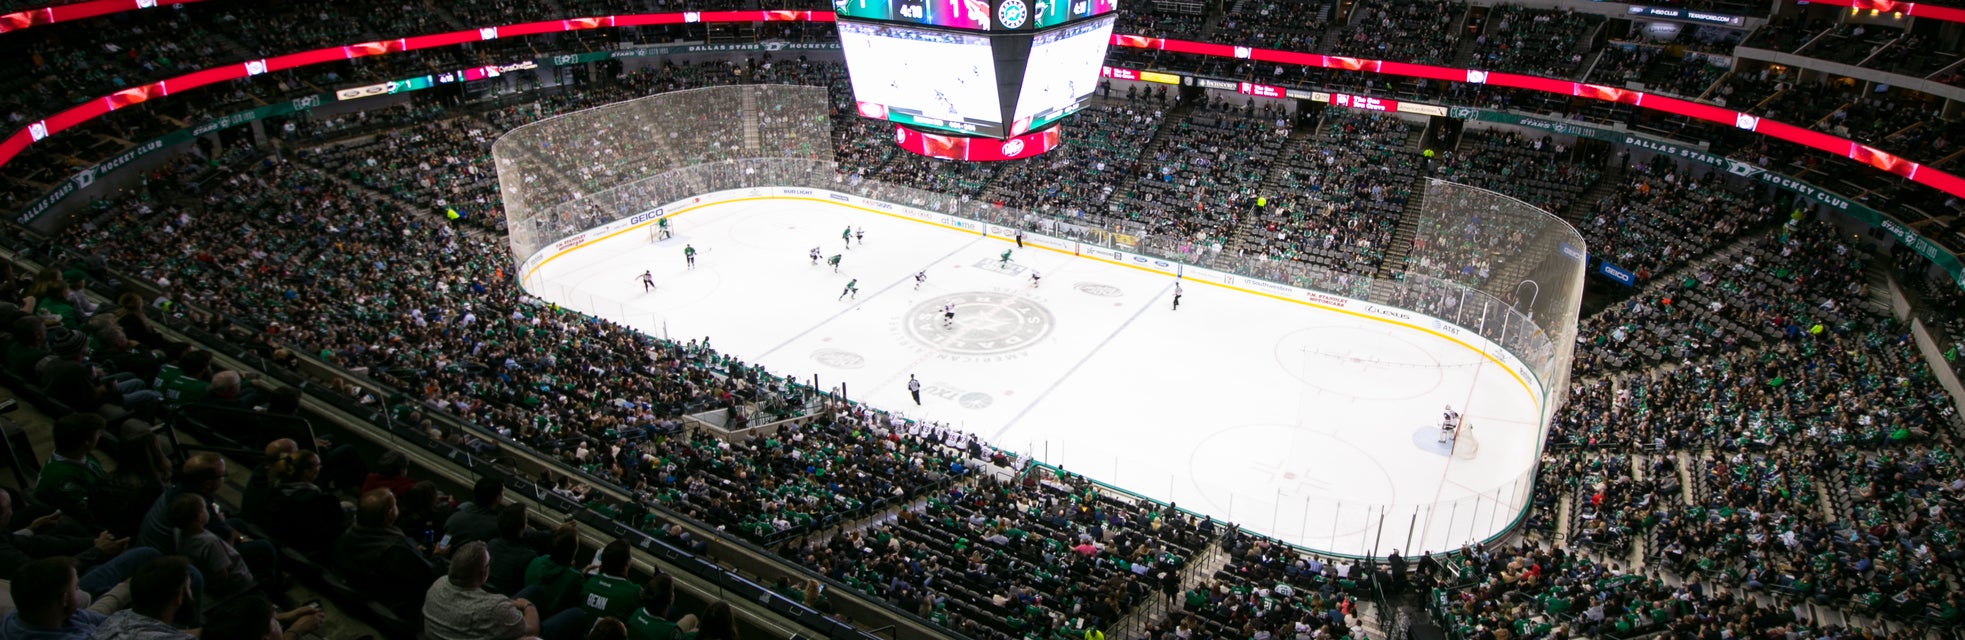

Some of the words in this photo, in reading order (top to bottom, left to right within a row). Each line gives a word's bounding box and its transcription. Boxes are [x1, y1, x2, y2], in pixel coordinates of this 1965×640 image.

[689, 44, 726, 52] DALLAS
[729, 43, 760, 51] STARS
[1353, 95, 1366, 103] The
[1367, 97, 1380, 105] One
[1368, 103, 1385, 111] Crave
[1519, 118, 1551, 129] STARS
[101, 151, 135, 173] HOCKEY
[137, 140, 163, 156] CLUB
[1625, 136, 1677, 154] DALLAS
[1681, 149, 1724, 167] STARS
[1763, 173, 1815, 195] HOCKEY
[1816, 192, 1849, 210] CLUB
[17, 199, 49, 225] DALLAS
[49, 182, 74, 204] STARS
[630, 208, 664, 225] GEICO
[1604, 266, 1629, 282] GEICO
[1252, 280, 1293, 293] Southwestern
[1376, 309, 1411, 320] LEXUS
[1442, 324, 1461, 337] AT&T
[586, 592, 609, 611] BENN
